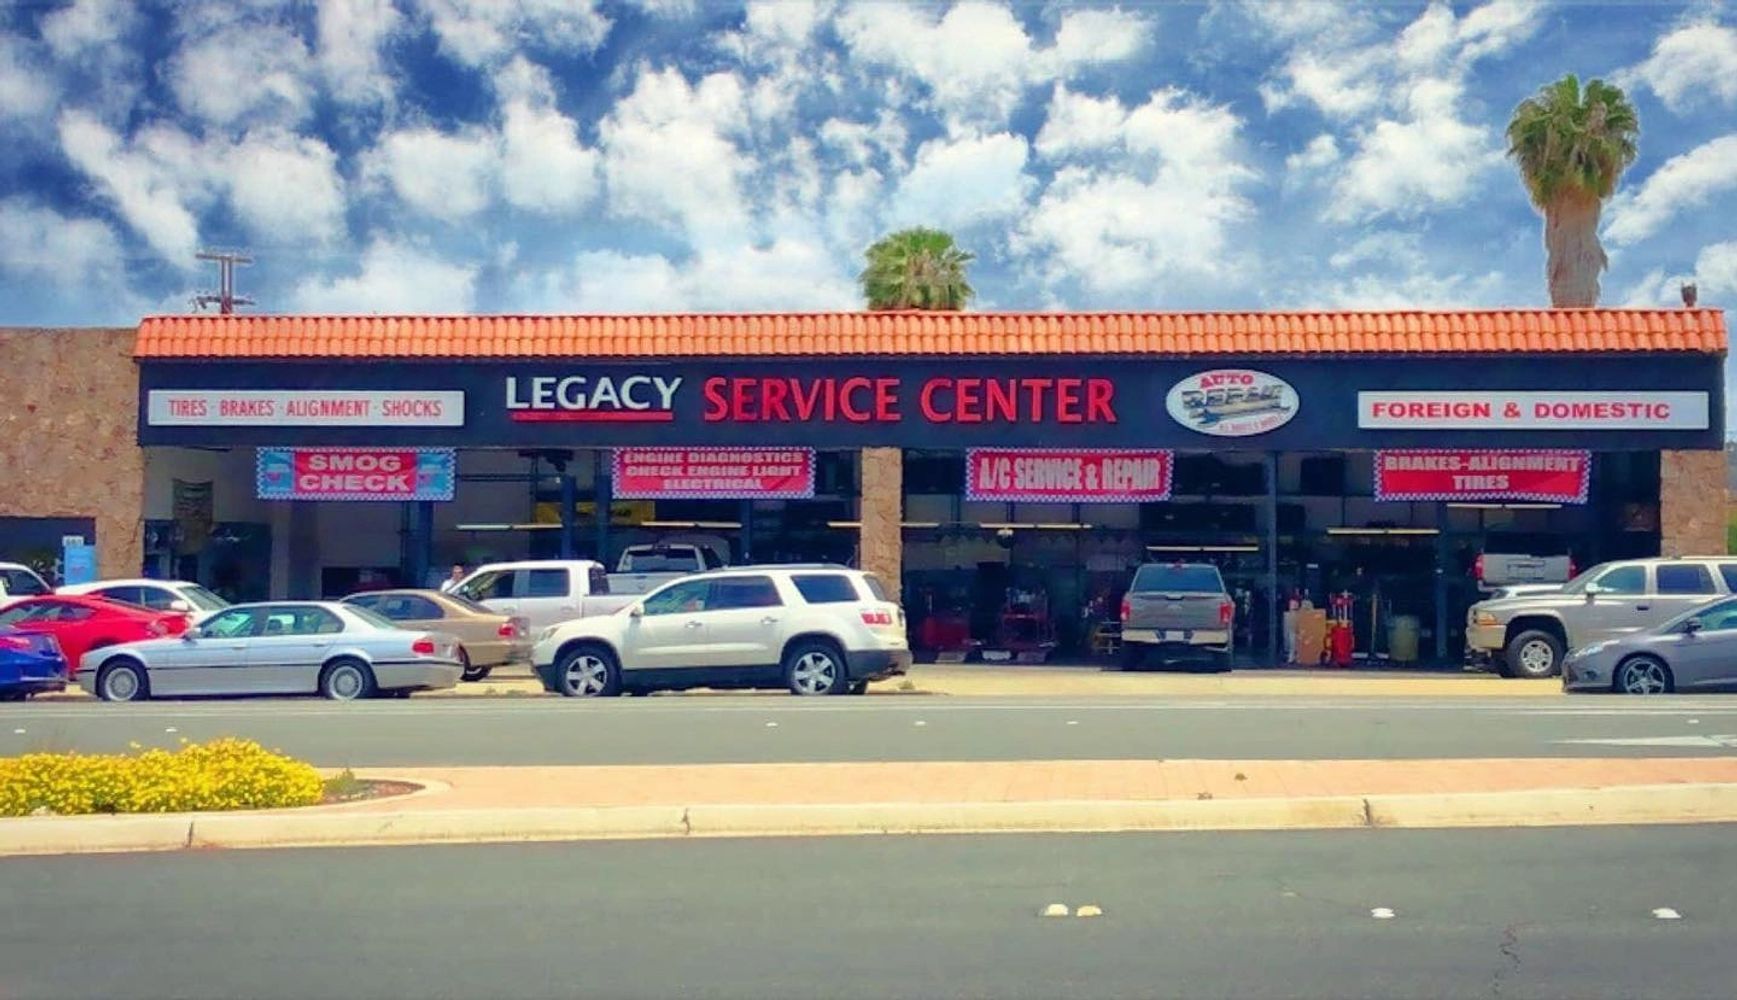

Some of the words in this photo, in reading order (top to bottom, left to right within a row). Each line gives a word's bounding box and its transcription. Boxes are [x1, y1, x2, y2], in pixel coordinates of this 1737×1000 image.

[1200, 374, 1253, 389] AUTO
[505, 376, 682, 410] LEGACY
[704, 377, 900, 422] SERVICE
[920, 378, 1117, 422] CENTER
[168, 399, 207, 417] TIRES
[219, 400, 274, 417] BRAKES
[286, 400, 371, 417] ALIGNMENT
[381, 400, 442, 417] SHOCKS
[1372, 402, 1491, 418] FOREIGN
[1503, 402, 1522, 418] &
[1534, 402, 1671, 419] DOMESTIC
[308, 455, 402, 471] SMOG
[623, 452, 684, 464] ENGINE
[688, 452, 804, 464] DIAGNOSTICS
[1384, 454, 1581, 471] BRAKES-ALIGNMENT
[625, 465, 687, 477] CHECK
[690, 465, 750, 477] ENGINE
[753, 465, 801, 477] LIGHT
[979, 457, 1010, 489] A/C
[1014, 457, 1082, 490] SERVICE
[1085, 462, 1098, 490] &
[1102, 458, 1161, 490] REPAIR
[299, 474, 410, 492] CHECK
[662, 478, 763, 490] ELECTRICAL
[1452, 475, 1509, 490] TIRES
